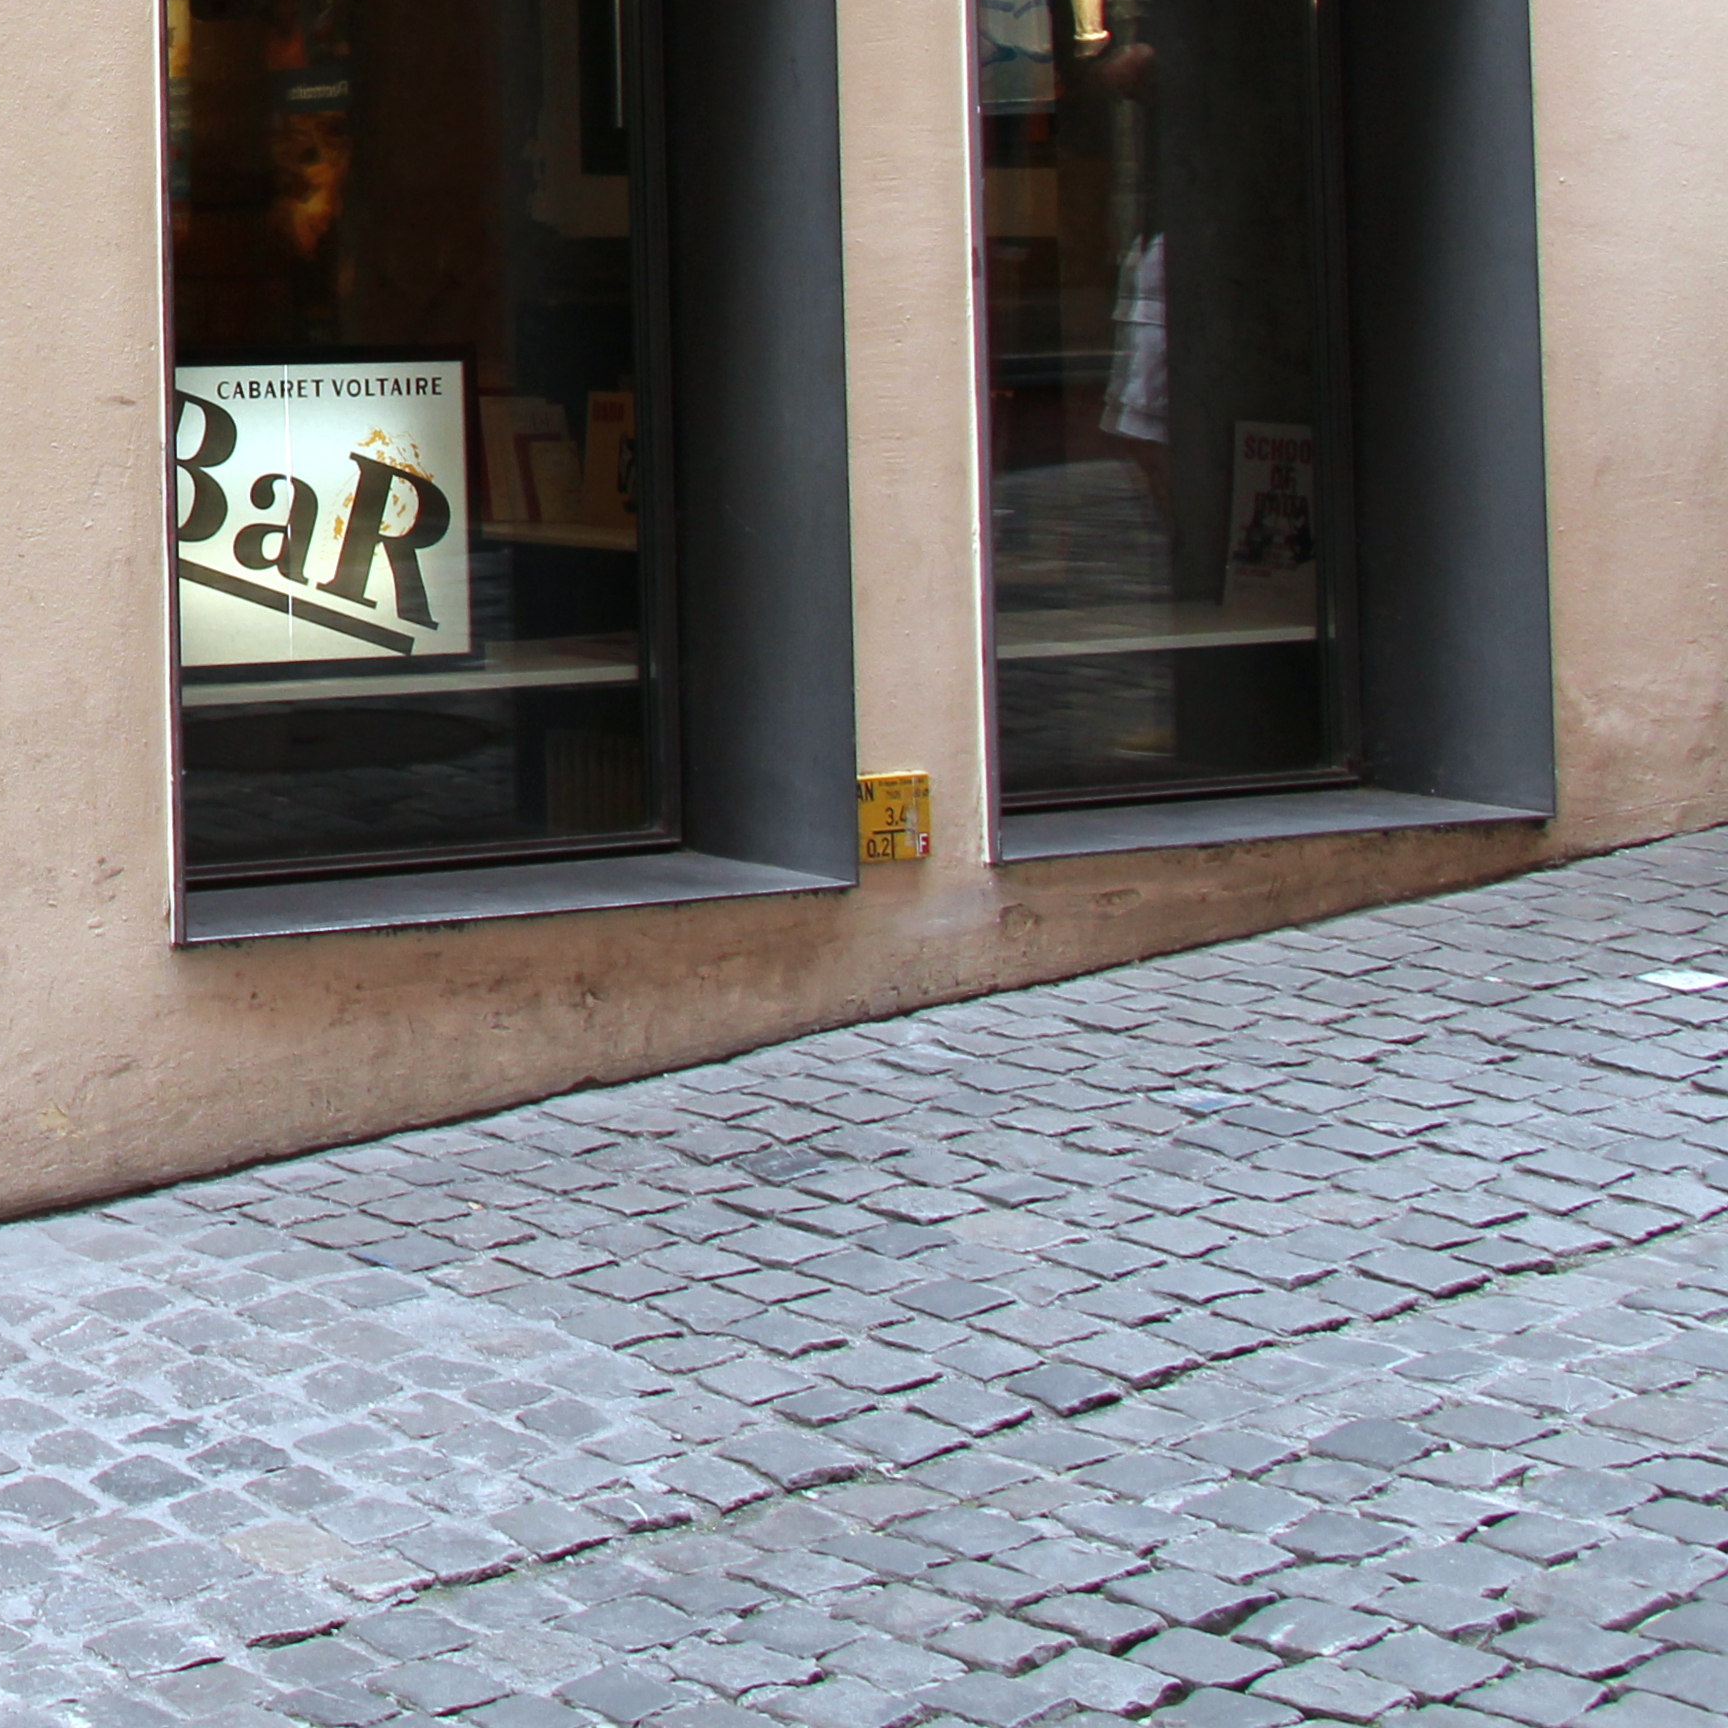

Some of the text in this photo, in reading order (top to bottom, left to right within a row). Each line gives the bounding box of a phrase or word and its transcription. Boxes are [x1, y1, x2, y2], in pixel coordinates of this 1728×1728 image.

[216, 376, 443, 400] CABARET VOLTAIRE
[176, 389, 451, 631] BaR
